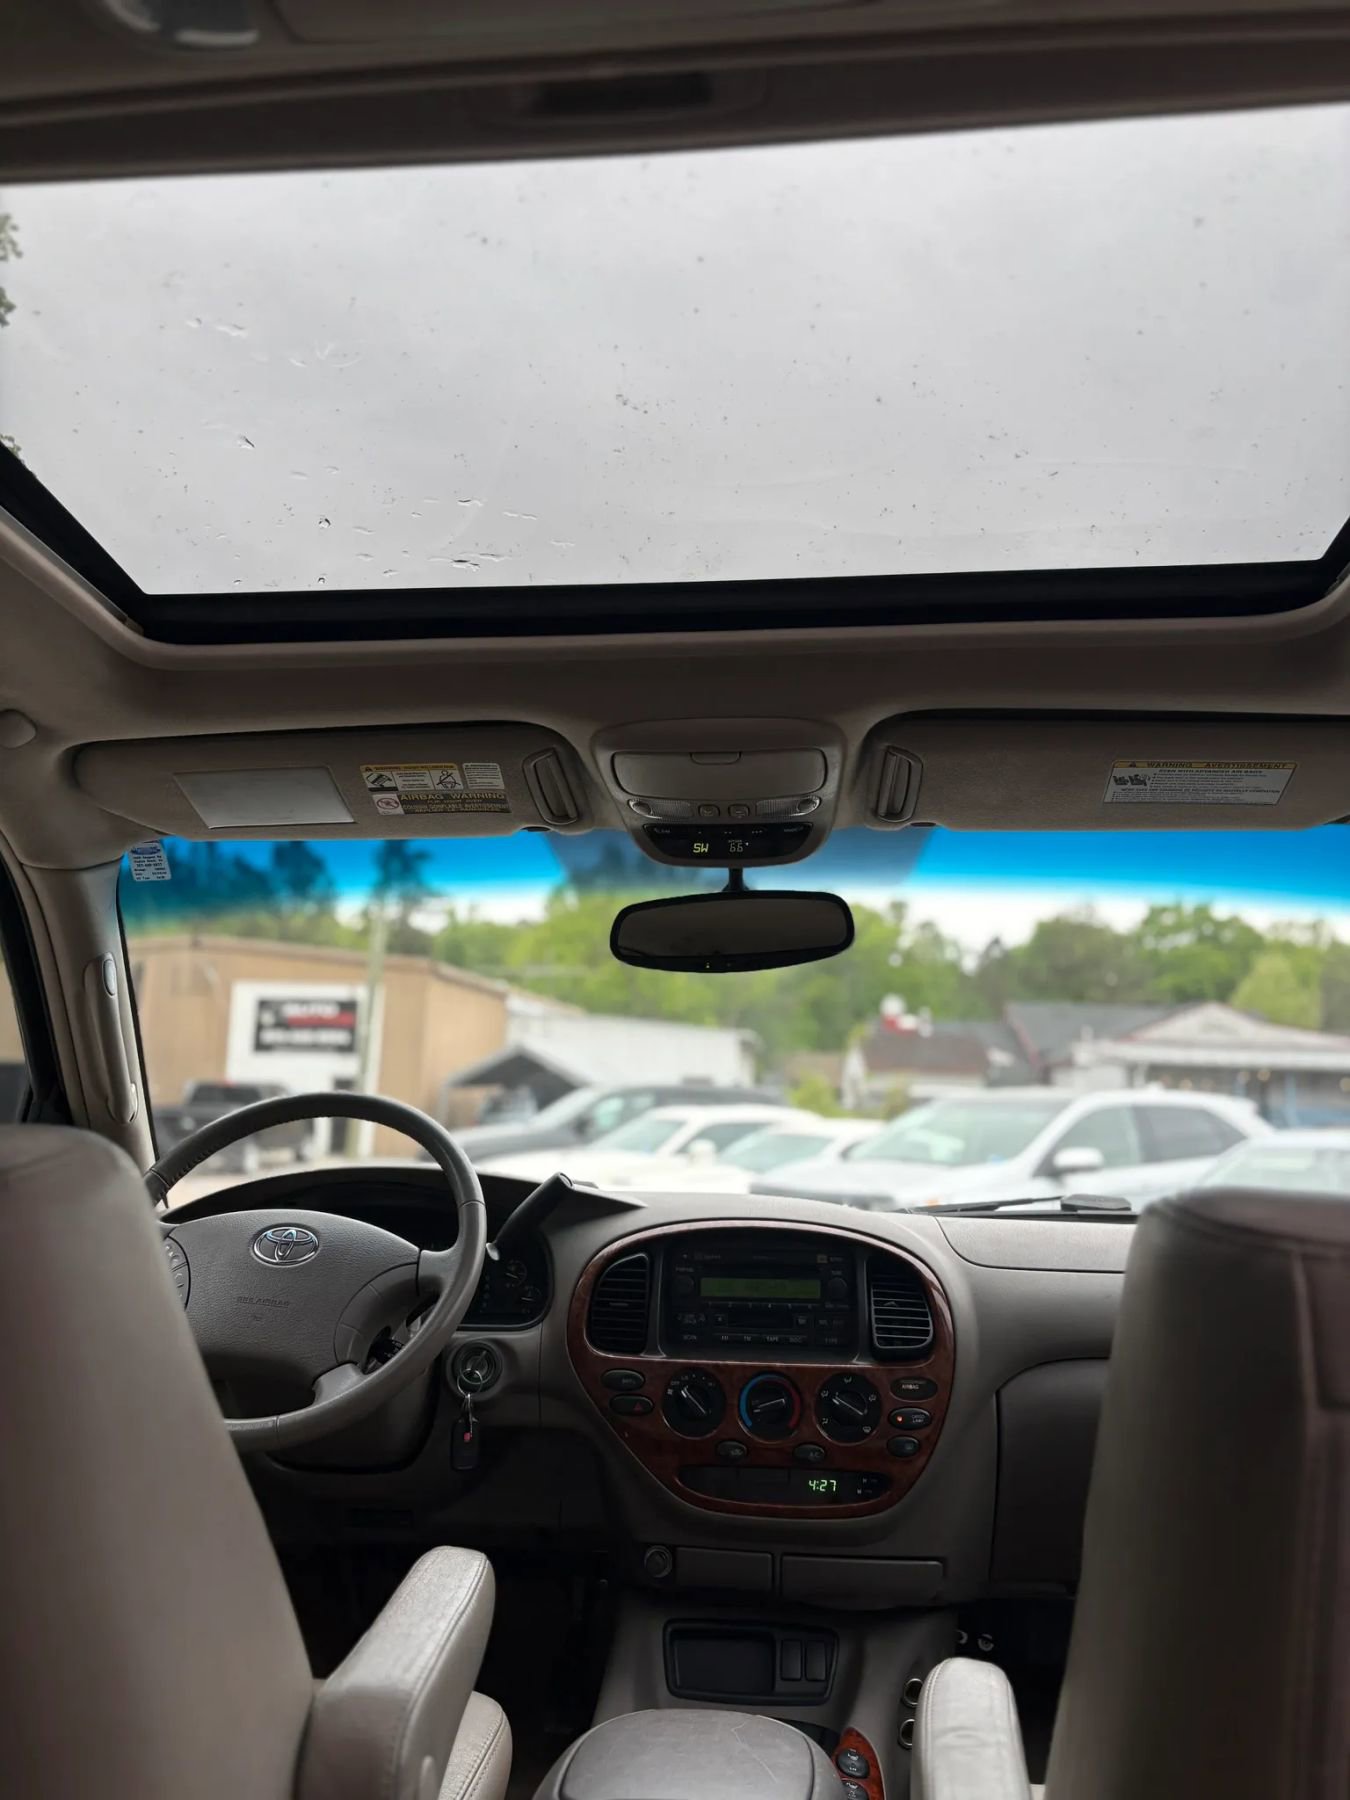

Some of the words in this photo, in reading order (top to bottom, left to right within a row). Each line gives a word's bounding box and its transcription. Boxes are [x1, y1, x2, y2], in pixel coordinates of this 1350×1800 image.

[401, 793, 444, 801] AIRBAG
[450, 792, 505, 800] WARNING
[692, 843, 710, 853] SW
[808, 1479, 837, 1492] 4:27
